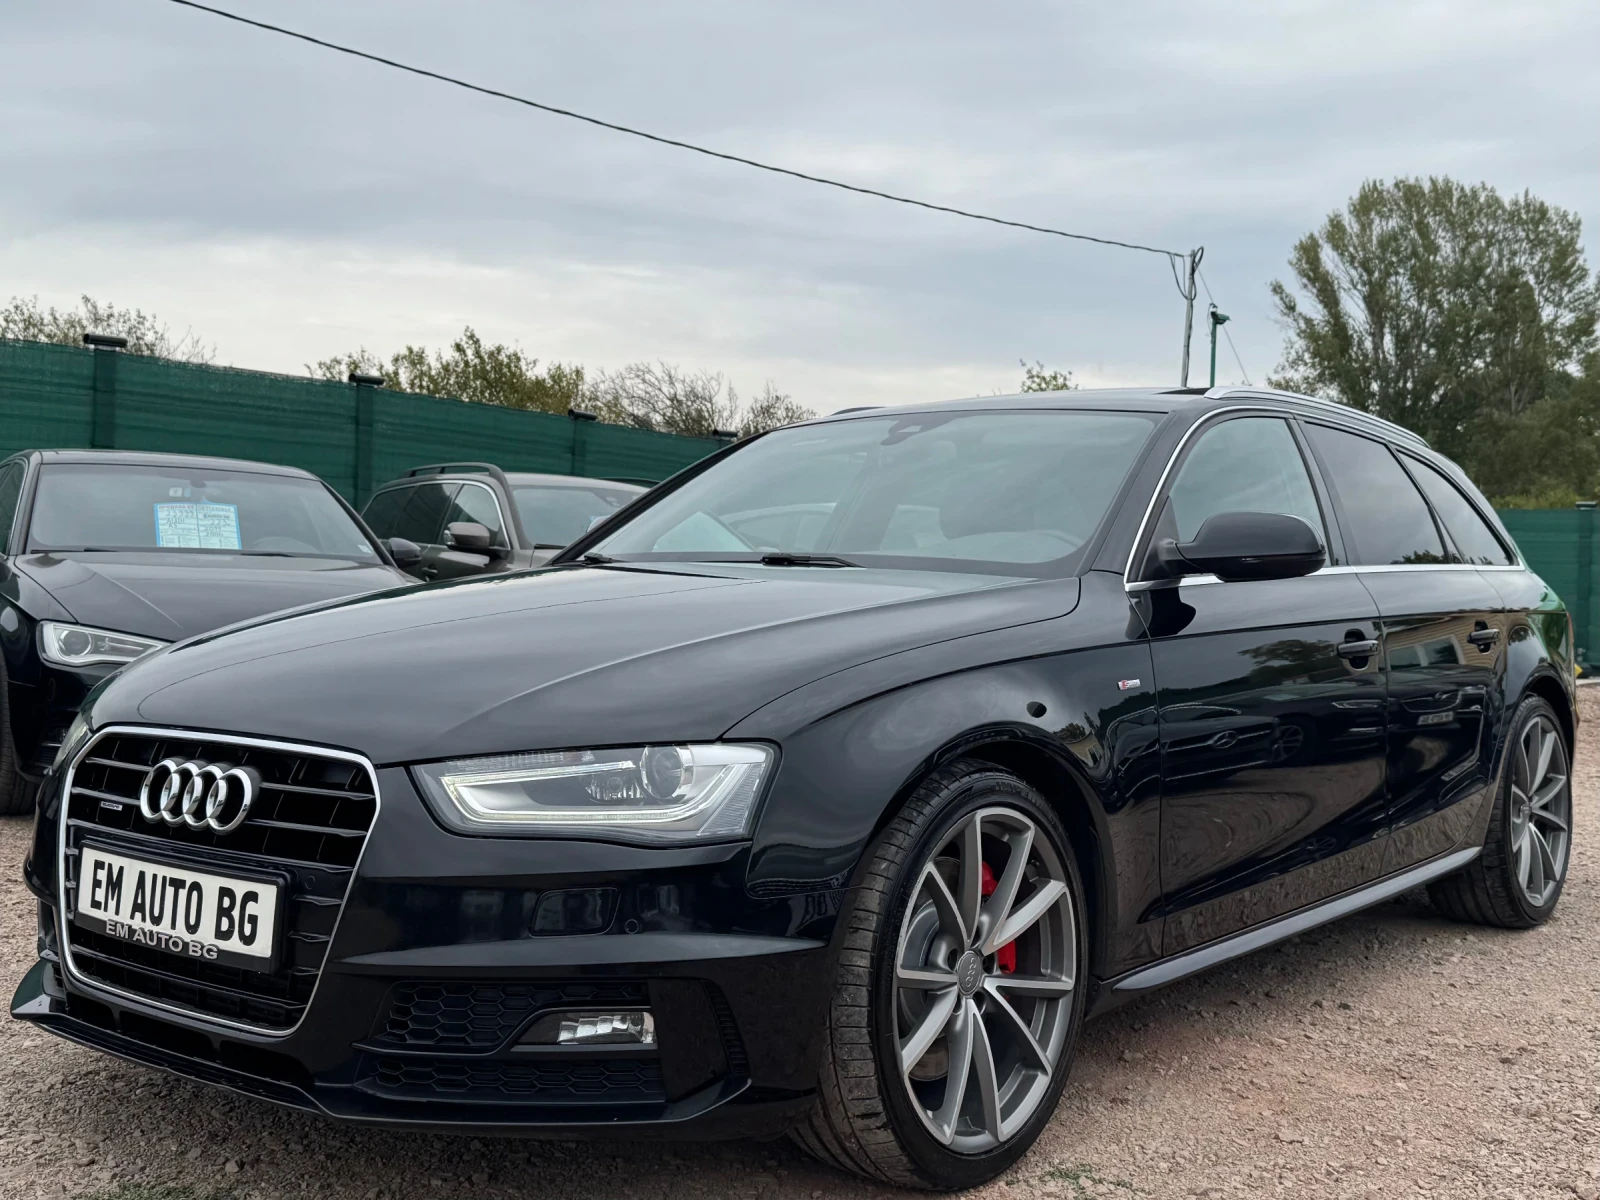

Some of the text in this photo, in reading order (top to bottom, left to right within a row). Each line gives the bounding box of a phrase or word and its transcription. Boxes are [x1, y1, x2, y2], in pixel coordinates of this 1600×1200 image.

[91, 859, 259, 946] EM AUTO BG
[105, 919, 219, 960] EM AUTO BG
